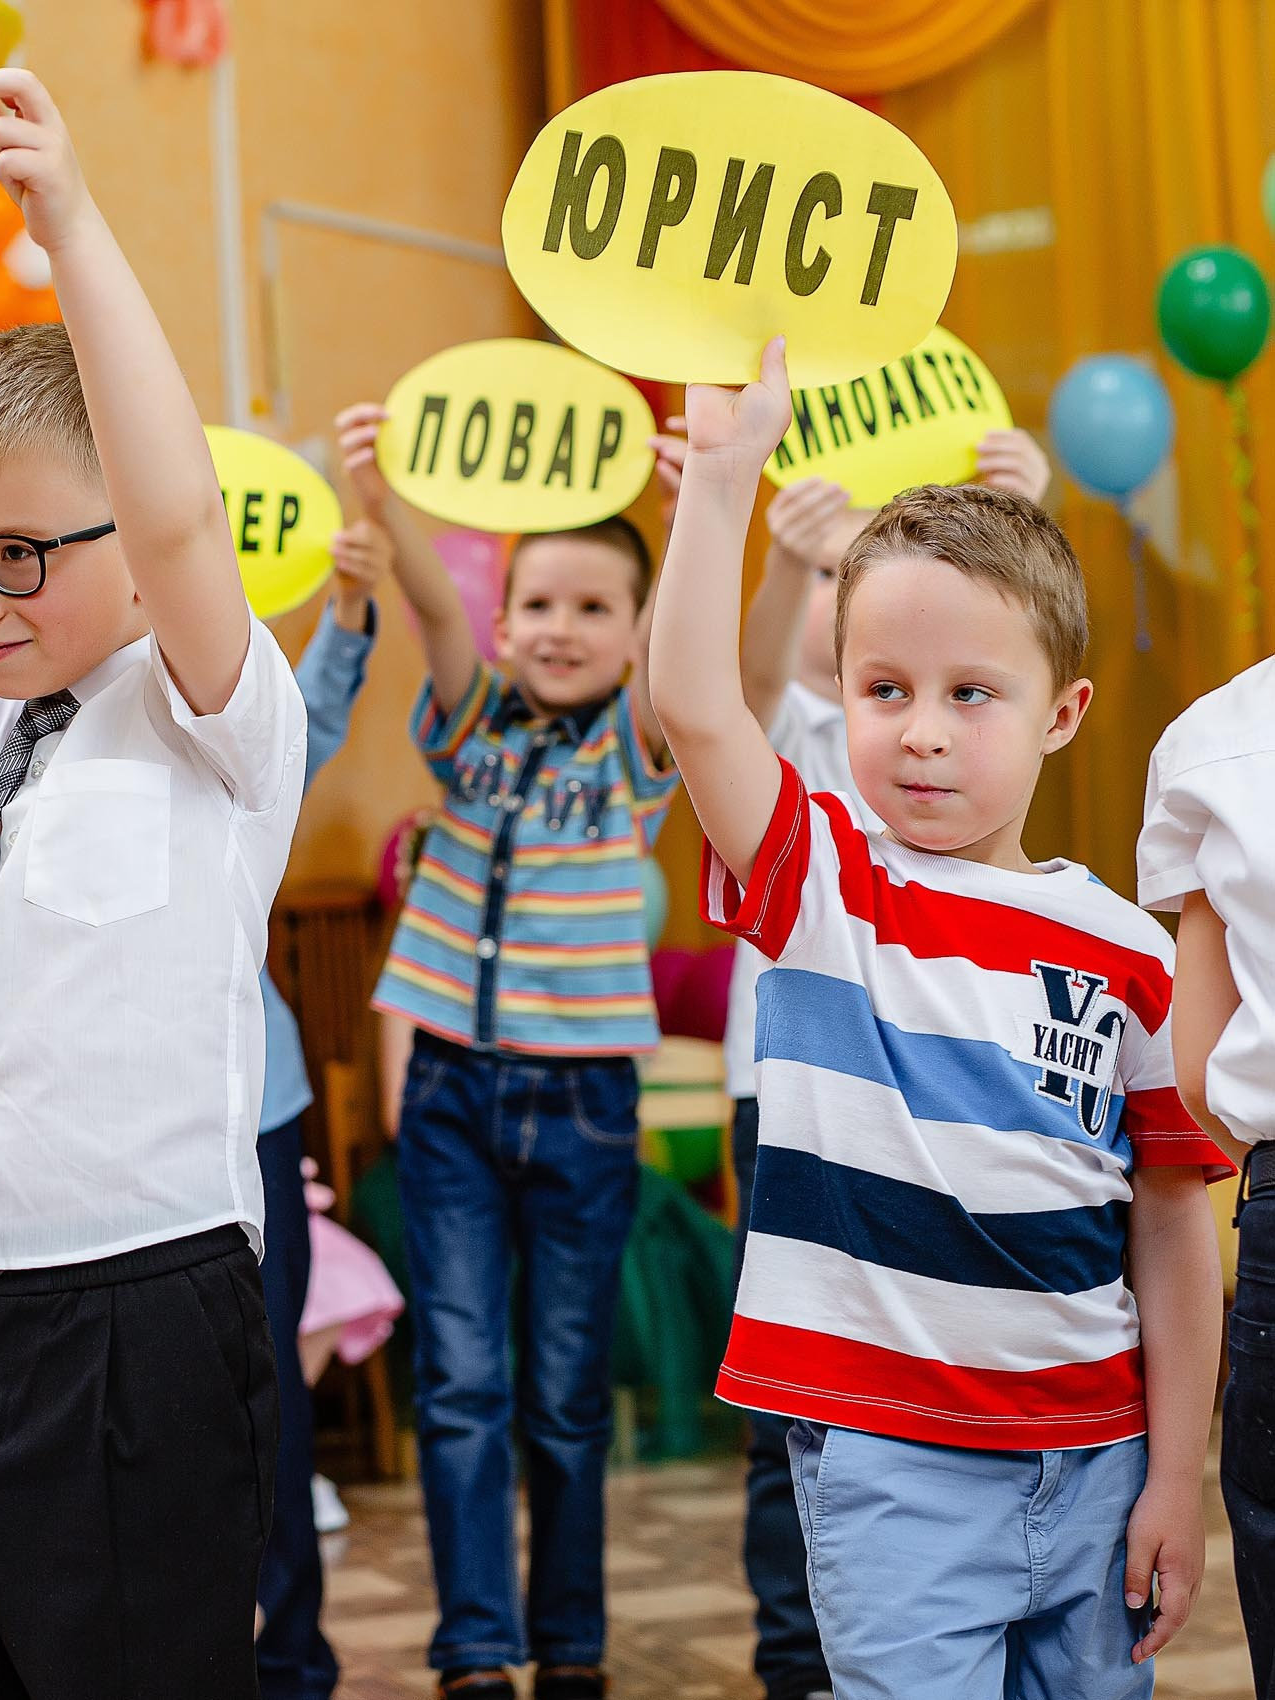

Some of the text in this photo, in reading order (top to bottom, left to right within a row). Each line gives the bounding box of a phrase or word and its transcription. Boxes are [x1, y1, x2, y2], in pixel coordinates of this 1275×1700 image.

[543, 130, 918, 306] ЮРИСТ
[409, 395, 624, 491] ПОВАР
[221, 487, 300, 554] ЕР
[1033, 1022, 1103, 1076] YACHT
